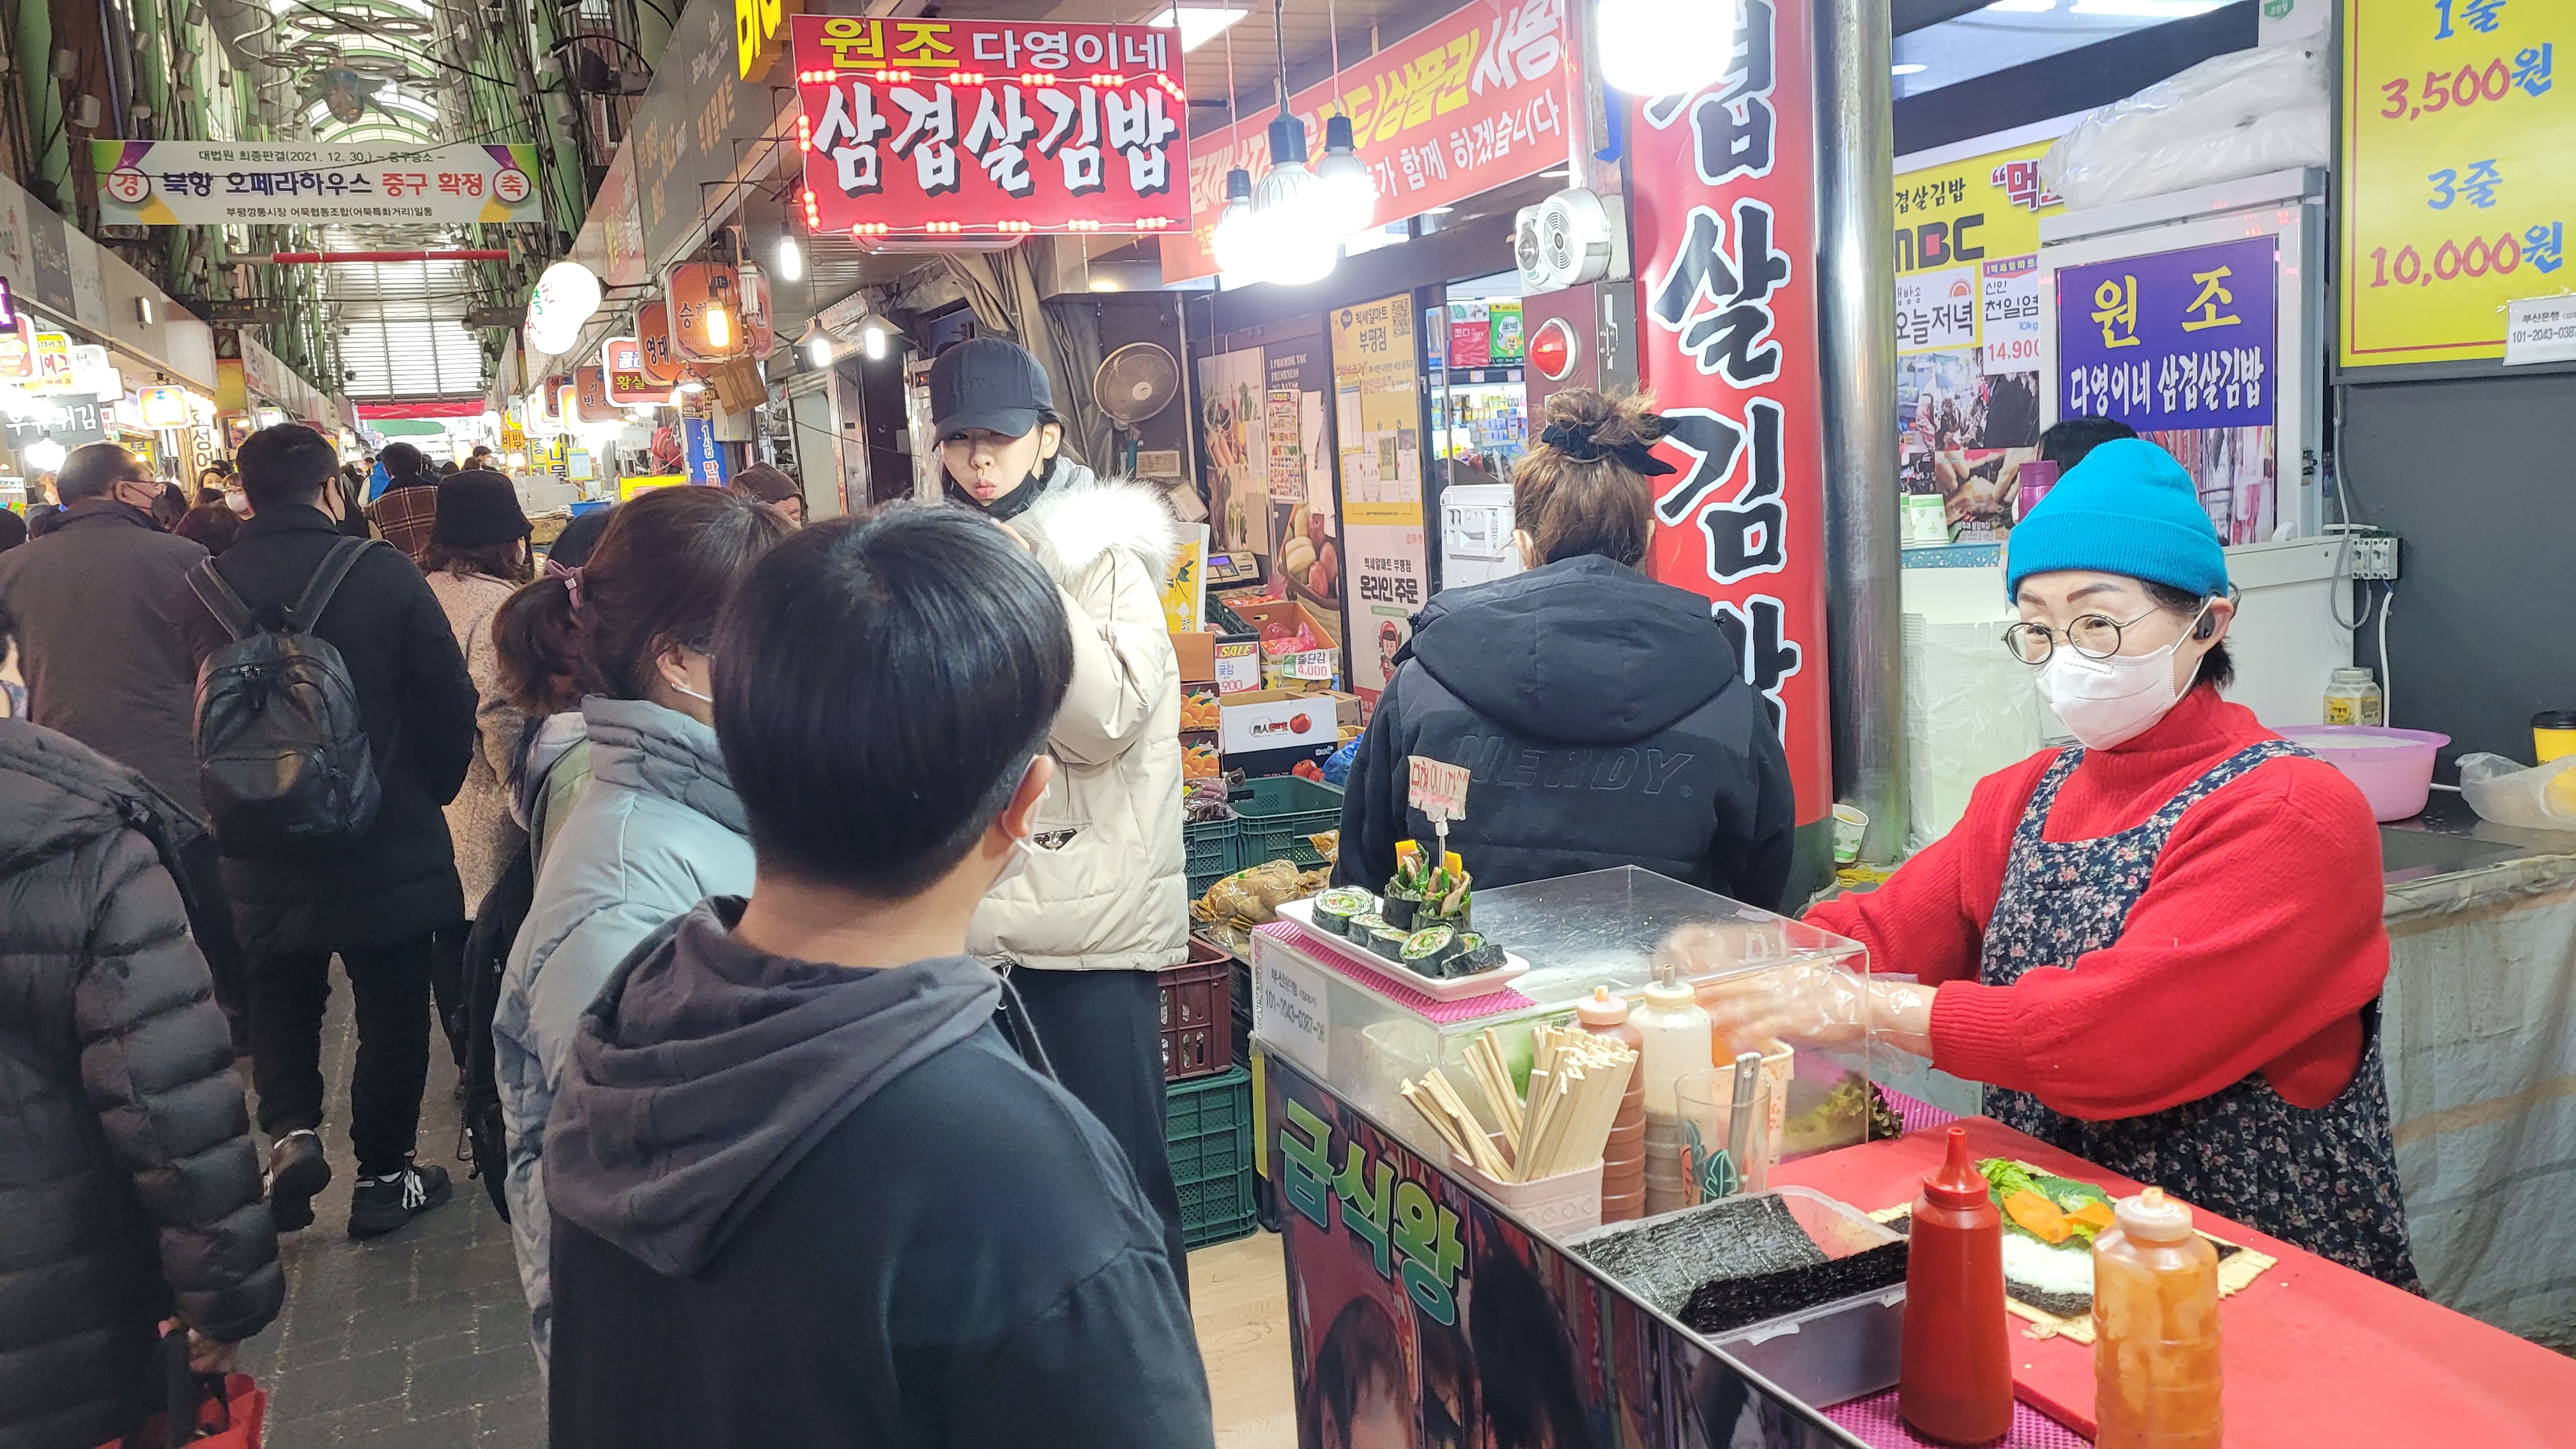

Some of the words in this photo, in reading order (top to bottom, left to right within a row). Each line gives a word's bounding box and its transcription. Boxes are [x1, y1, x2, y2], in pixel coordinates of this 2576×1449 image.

[820, 18, 960, 69] 원조
[972, 29, 1168, 72] 다영이네
[2381, 42, 2553, 121] 3,500원
[812, 81, 1177, 195] 삼겹살김밥
[1400, 137, 1448, 190] 함께
[1449, 88, 1561, 171] 하겠습니다
[199, 150, 234, 162] 대법원
[116, 173, 139, 197] 경
[163, 171, 214, 197] 북항
[225, 172, 373, 197] 오페라하우스
[382, 172, 428, 197] 중구
[438, 172, 484, 197] 확정
[500, 174, 523, 196] 축
[2427, 158, 2504, 210] 3줄
[2370, 220, 2563, 288] 10,000원
[1986, 280, 2007, 295] 신안
[1356, 305, 1388, 327] 빅세일마트
[2522, 311, 2559, 324] 부산은행
[1360, 326, 1387, 353] 부평점
[2070, 358, 2151, 417] 다영이네
[2157, 345, 2266, 414] 삼겹살김밥
[1393, 558, 1411, 572] 부평점
[1360, 575, 1393, 602] 온라인
[1395, 578, 1418, 604] 주문
[1220, 644, 1253, 658] SALE
[1298, 664, 1327, 677] 4,000
[1271, 967, 1298, 997] 부산은행
[1279, 1097, 1464, 1326] 급식왕
